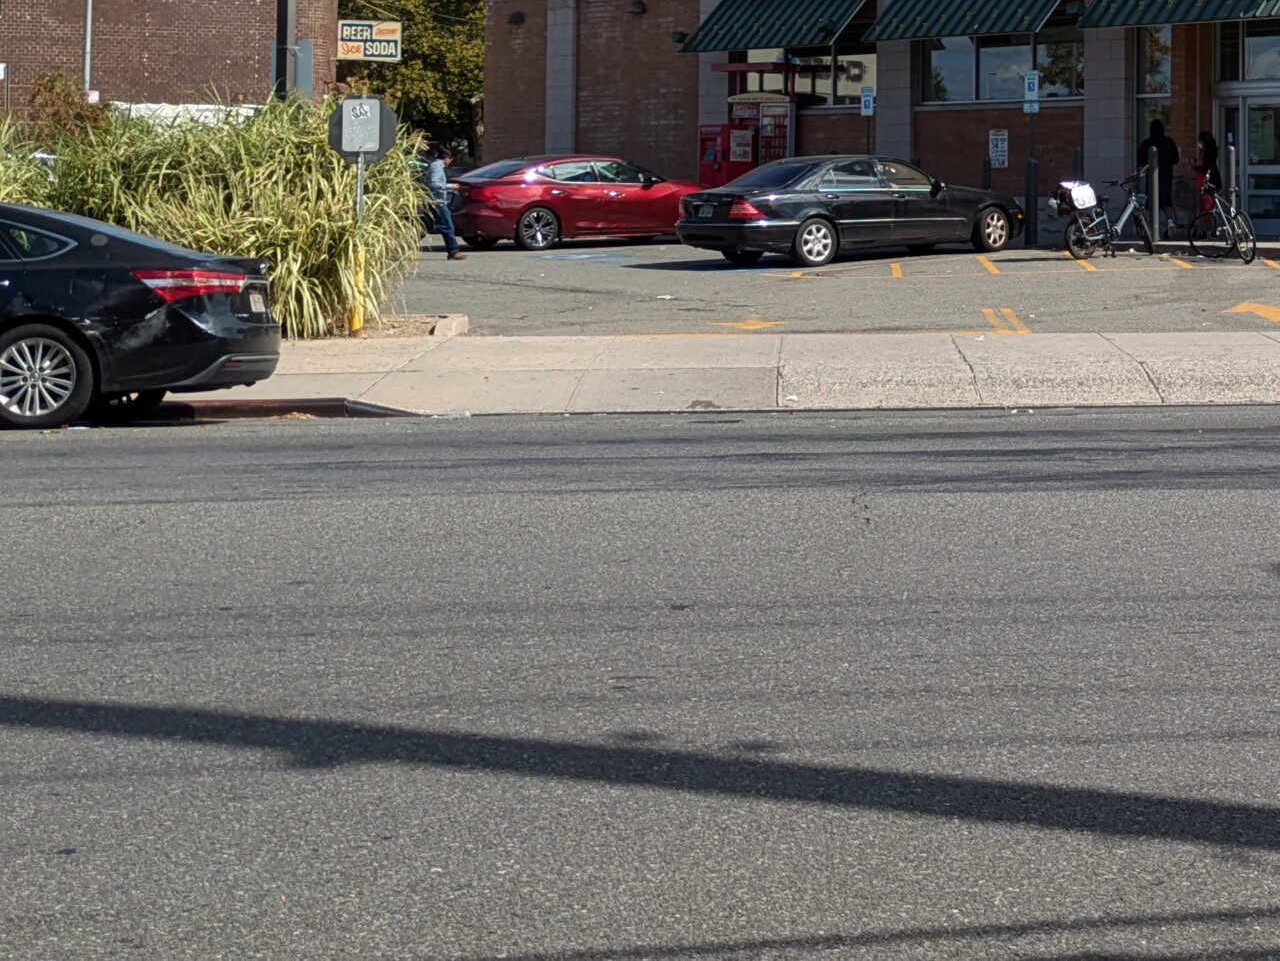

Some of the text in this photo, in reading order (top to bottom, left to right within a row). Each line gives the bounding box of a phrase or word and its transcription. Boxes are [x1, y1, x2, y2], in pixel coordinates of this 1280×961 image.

[342, 25, 372, 40] BEER
[341, 42, 362, 56] Ice
[365, 41, 397, 56] SODA
